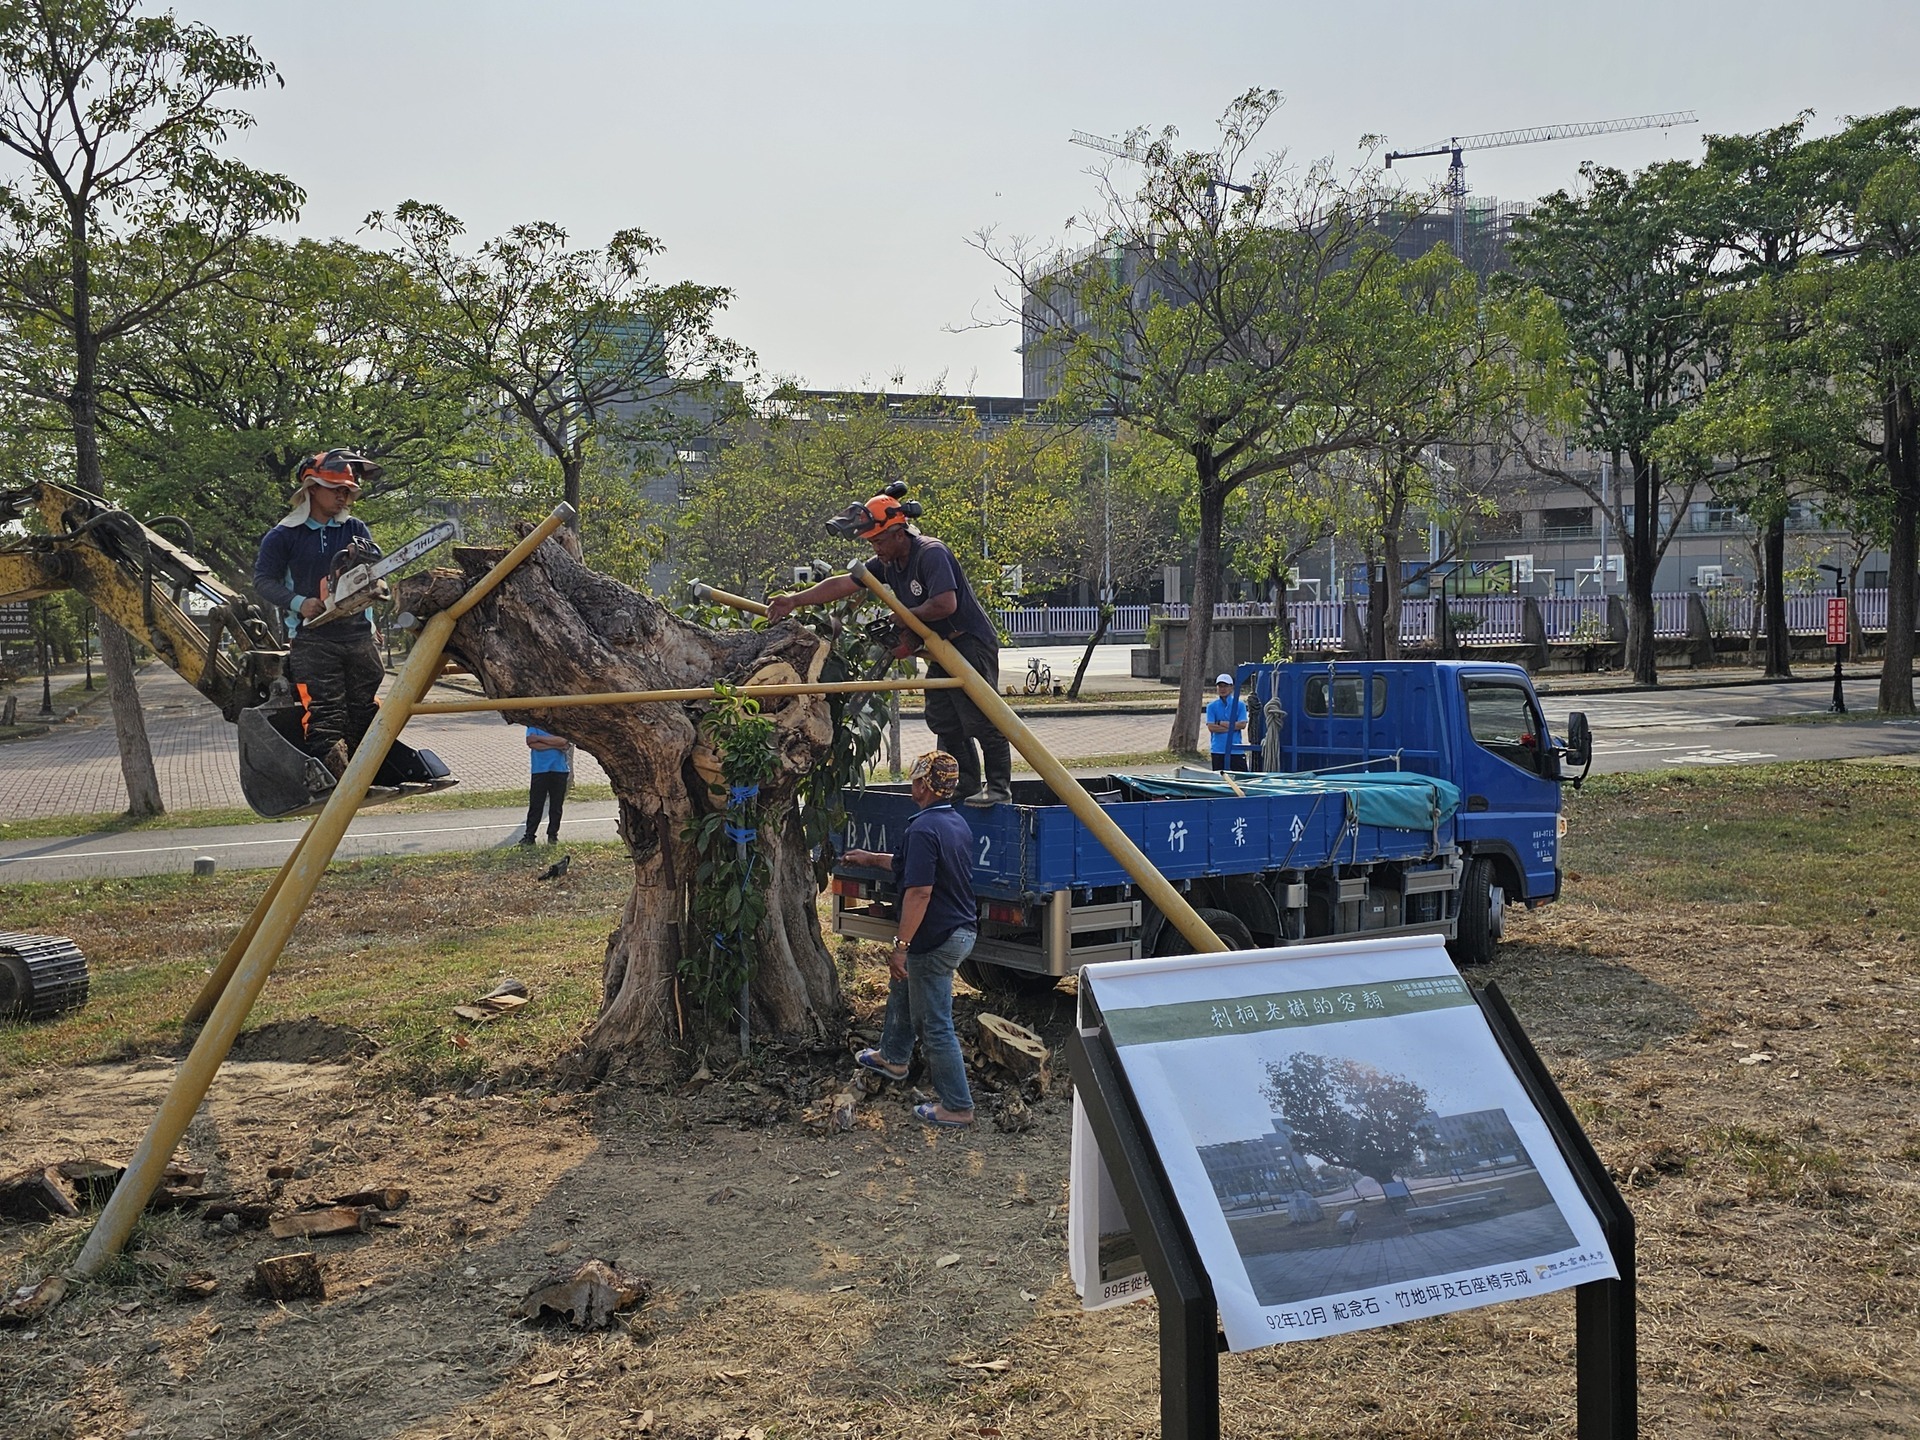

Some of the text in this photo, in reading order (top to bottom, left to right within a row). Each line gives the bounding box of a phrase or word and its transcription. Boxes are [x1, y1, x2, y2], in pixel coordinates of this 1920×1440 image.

[1210, 990, 1386, 1029] 刺桐老樹的容顏
[1266, 1268, 1532, 1330] 92年12月 紀念石、竹地坪及石座椅完成
